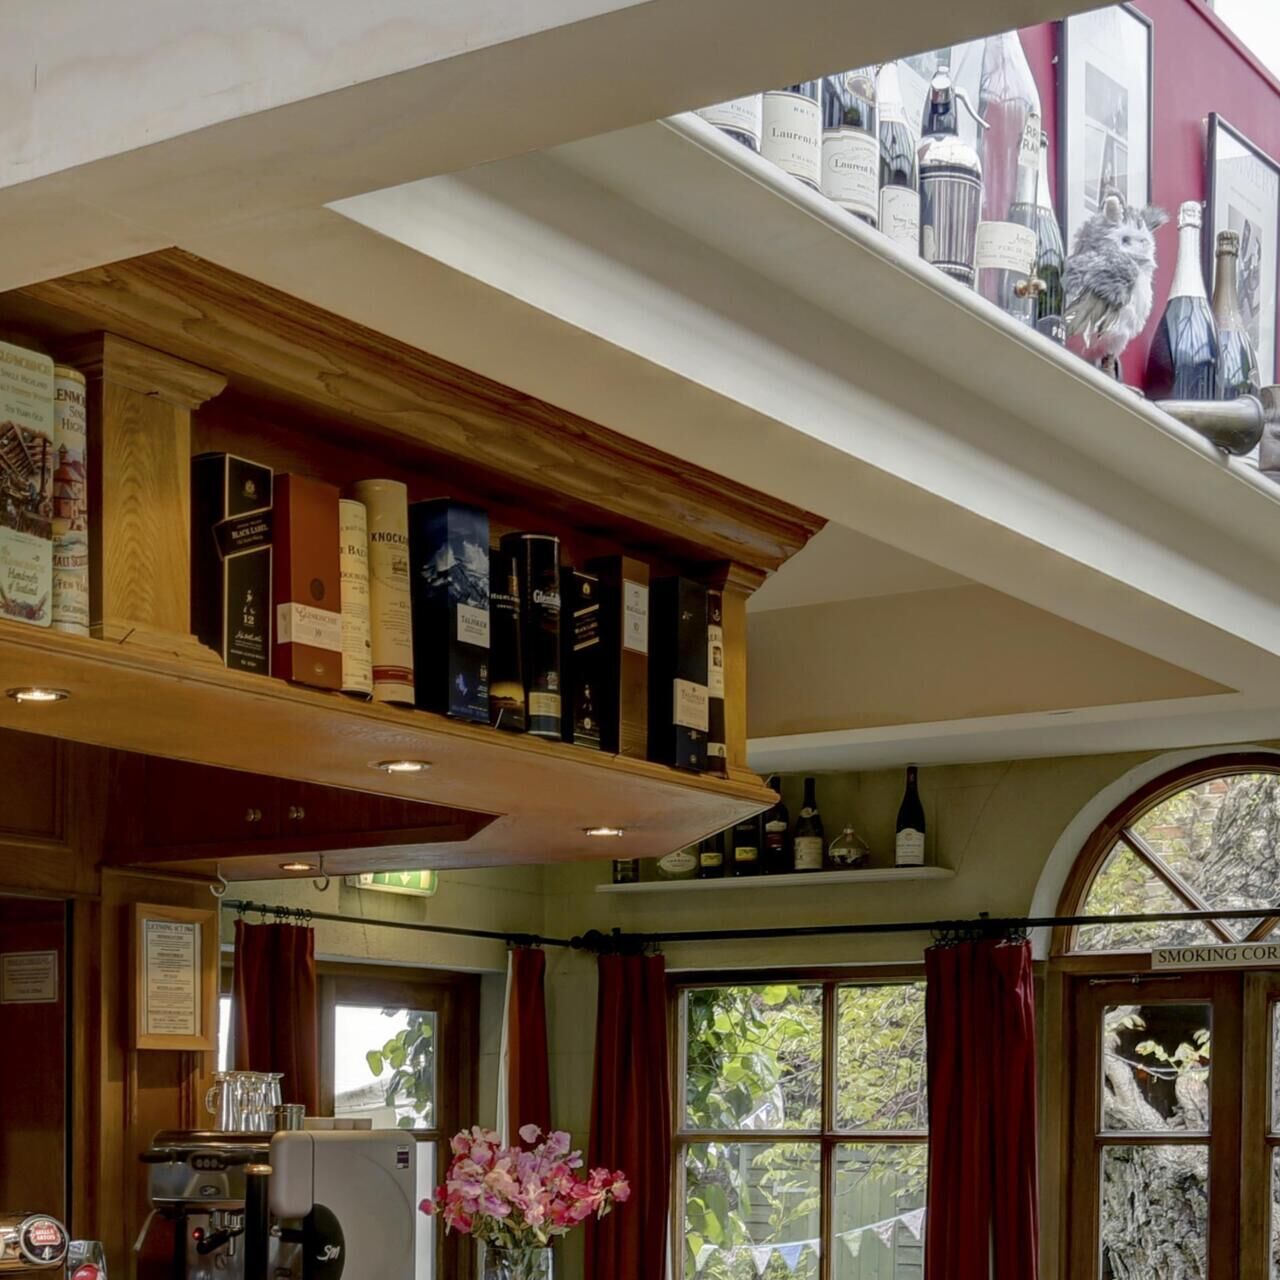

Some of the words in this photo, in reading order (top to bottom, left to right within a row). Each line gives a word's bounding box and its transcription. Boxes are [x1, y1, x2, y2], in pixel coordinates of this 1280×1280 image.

[231, 528, 250, 540] BLACK
[250, 524, 269, 536] LABEL
[243, 614, 255, 626] 12
[1158, 947, 1237, 964] SMOKING
[36, 1234, 55, 1242] ARTOIS
